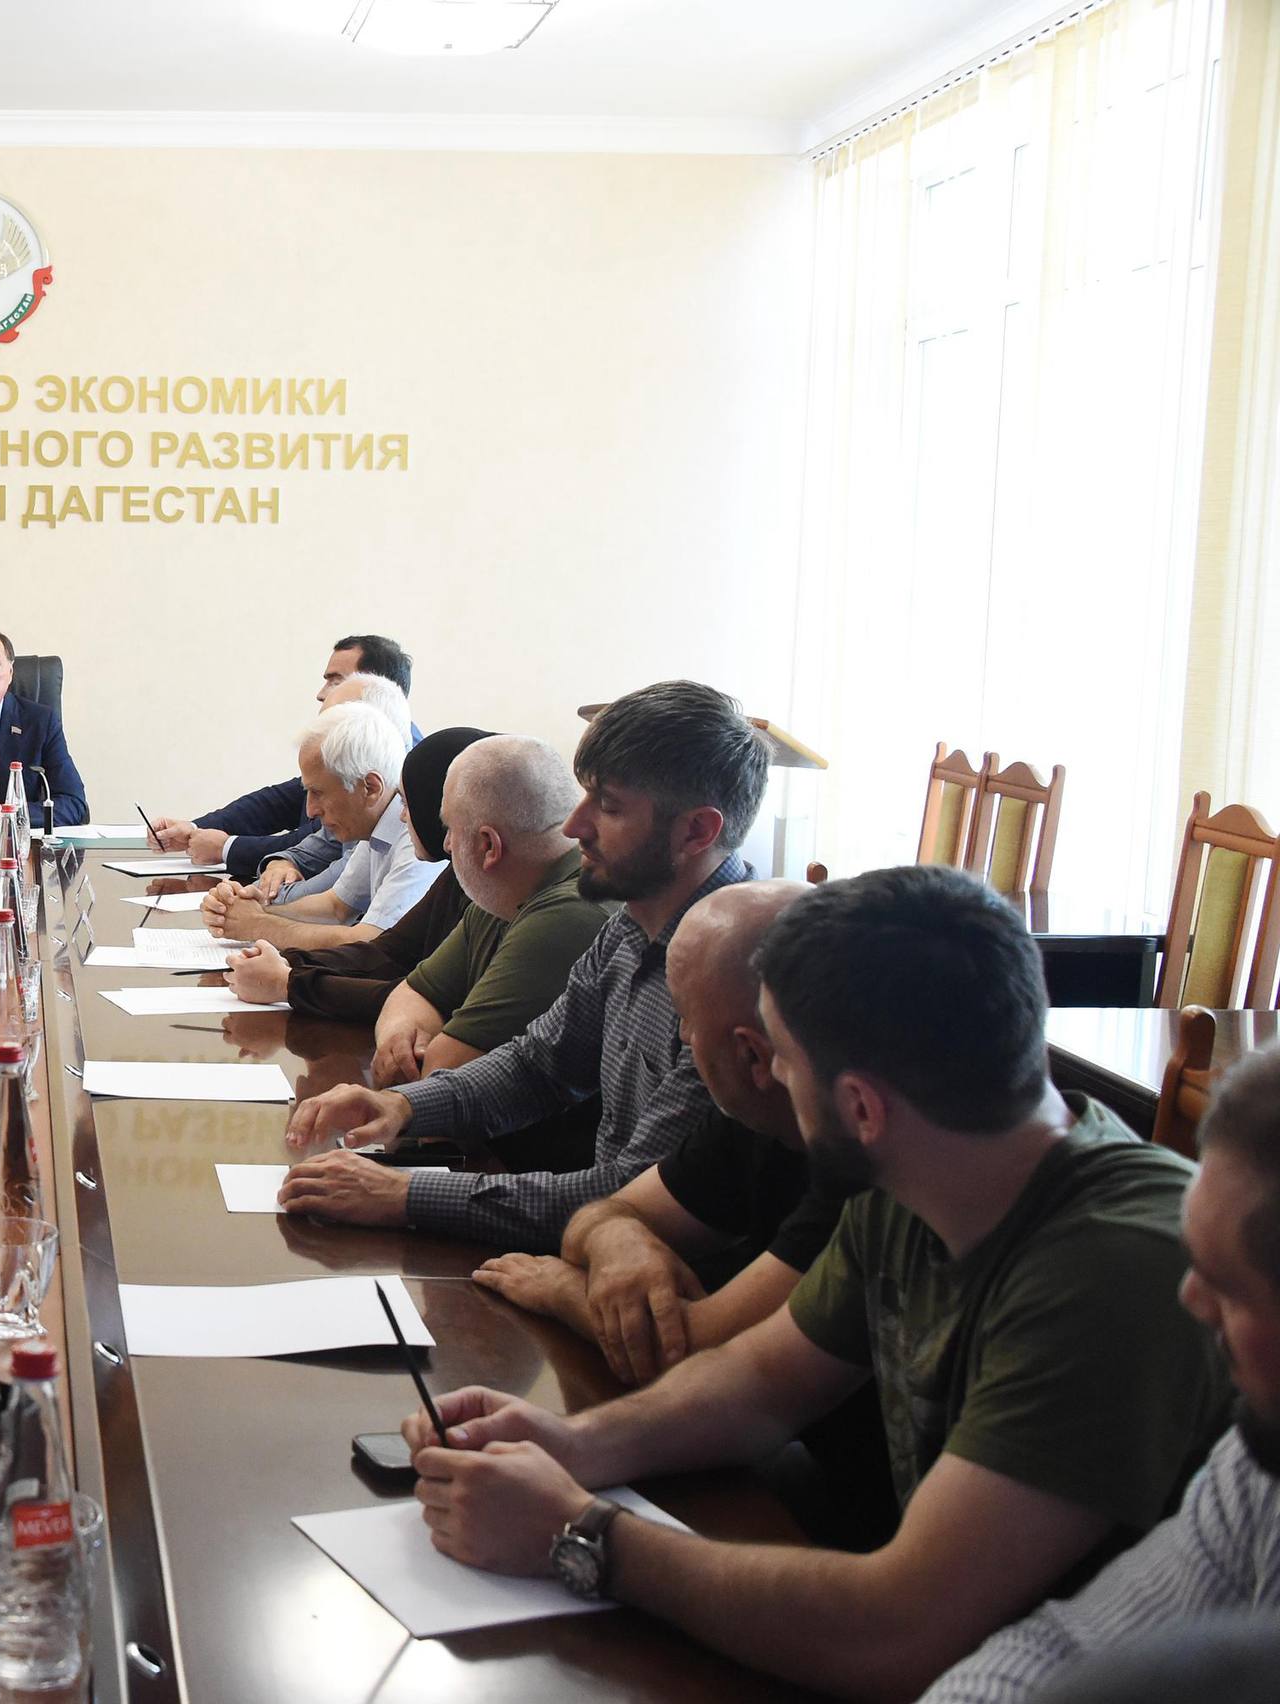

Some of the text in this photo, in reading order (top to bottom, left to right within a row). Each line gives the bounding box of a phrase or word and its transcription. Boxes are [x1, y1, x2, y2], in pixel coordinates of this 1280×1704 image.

[36, 376, 346, 415] ЭКОНОМИКИ
[151, 432, 408, 471] РАЗВИТИЯ
[21, 486, 279, 528] ДАГЕСТАН
